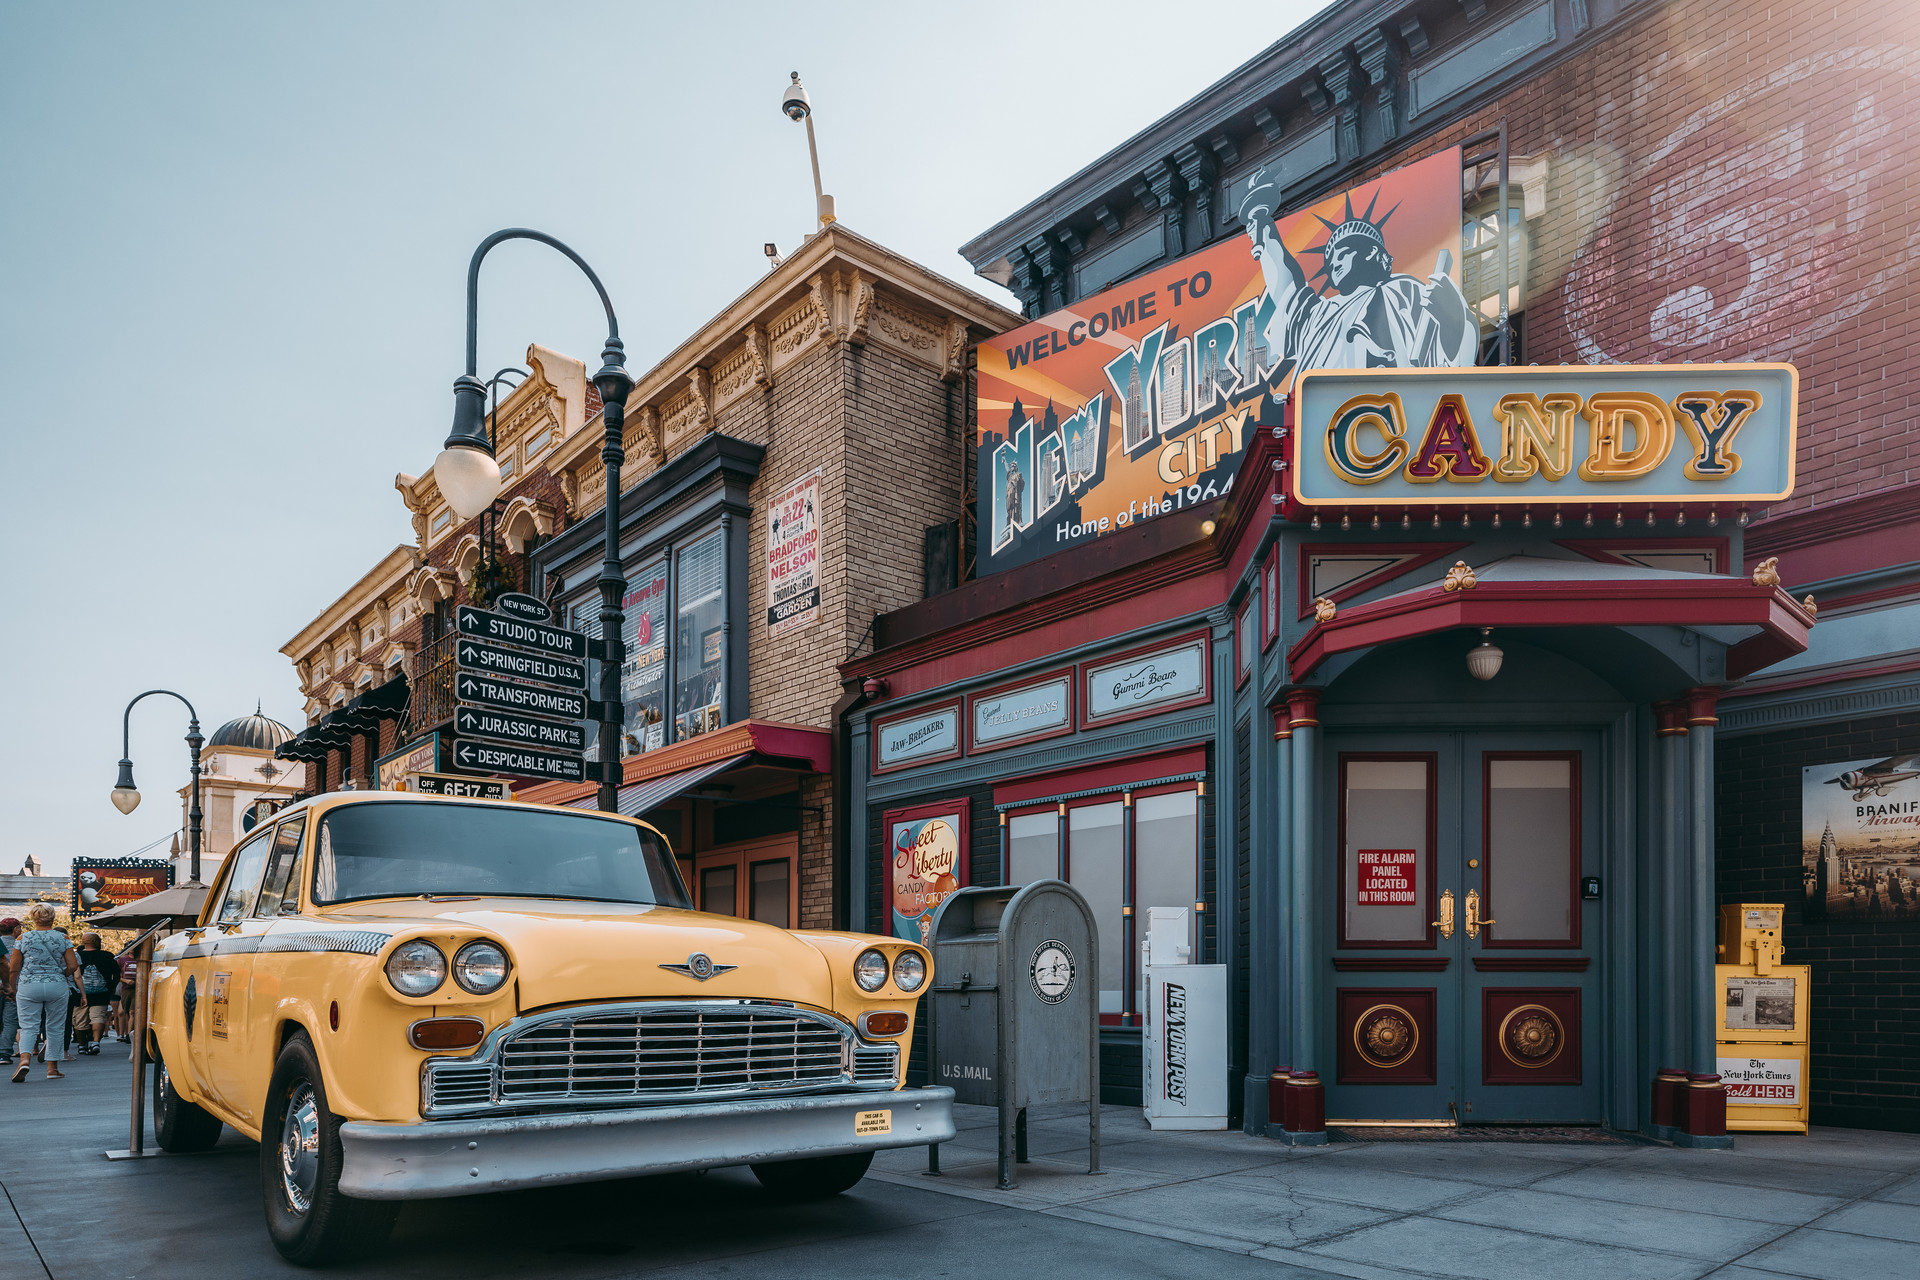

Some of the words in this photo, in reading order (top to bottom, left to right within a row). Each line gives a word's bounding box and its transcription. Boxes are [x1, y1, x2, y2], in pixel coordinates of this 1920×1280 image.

[1006, 291, 1157, 370] WELCOME
[1167, 270, 1212, 307] TO
[991, 389, 1104, 557] NEW
[1103, 287, 1285, 456] YORK
[1157, 405, 1252, 484] CITY
[1323, 389, 1763, 486] CANDY
[795, 484, 804, 495] YORK
[792, 498, 804, 521] 22
[1056, 514, 1110, 542] Home
[1116, 500, 1137, 525] of
[1142, 496, 1172, 517] the
[1175, 472, 1234, 510] 1964
[769, 529, 818, 563] BRADFORD
[771, 548, 816, 580] NELSON
[629, 586, 650, 607] Avenue
[651, 578, 665, 597] Gym
[773, 582, 797, 603] THOMAS
[802, 575, 814, 590] RAY
[503, 599, 518, 608] NEW
[519, 602, 536, 614] YORK
[536, 608, 546, 616] ST.
[776, 597, 812, 619] GARDEN
[489, 619, 537, 643] STUDIO
[539, 631, 573, 651] TOUR
[480, 651, 557, 678] SPRINGFIELD
[558, 665, 581, 680] U.S.A.
[638, 653, 650, 669] NEW
[479, 682, 581, 714] TRANSFORMERS
[1113, 677, 1145, 700] Gummi
[989, 710, 1021, 726] JELLY
[1022, 700, 1059, 719] BEANS
[478, 716, 537, 739] JURASSIC
[539, 725, 569, 744] PARK
[569, 730, 579, 739] THE
[569, 737, 580, 746] RIDE
[891, 720, 945, 752] JAW-BREAKERS
[478, 749, 544, 771] DESPICABLE
[546, 759, 562, 774] ME
[563, 760, 579, 769] MINION
[421, 780, 435, 788] OFF
[896, 822, 944, 869] Sweet
[1359, 853, 1380, 864] FIRE
[1381, 853, 1415, 864] ALARM
[907, 848, 953, 880] Liberty
[1372, 866, 1402, 876] PANEL
[95, 883, 160, 897] PANDA
[105, 876, 138, 885] KUNG
[897, 882, 926, 895] CANDY
[1366, 878, 1408, 889] LOCATED
[1359, 891, 1368, 902] IN
[1369, 891, 1388, 902] THIS
[1389, 891, 1415, 902] ROOM
[1167, 982, 1186, 1022] NEW
[1167, 1020, 1186, 1065] YORK
[1723, 1070, 1742, 1079] New
[1743, 1070, 1764, 1081] York
[1765, 1070, 1791, 1080] Times
[1749, 1059, 1766, 1069] The
[1167, 1061, 1186, 1106] POST
[1725, 1084, 1753, 1097] Sold
[1755, 1086, 1794, 1098] HERE
